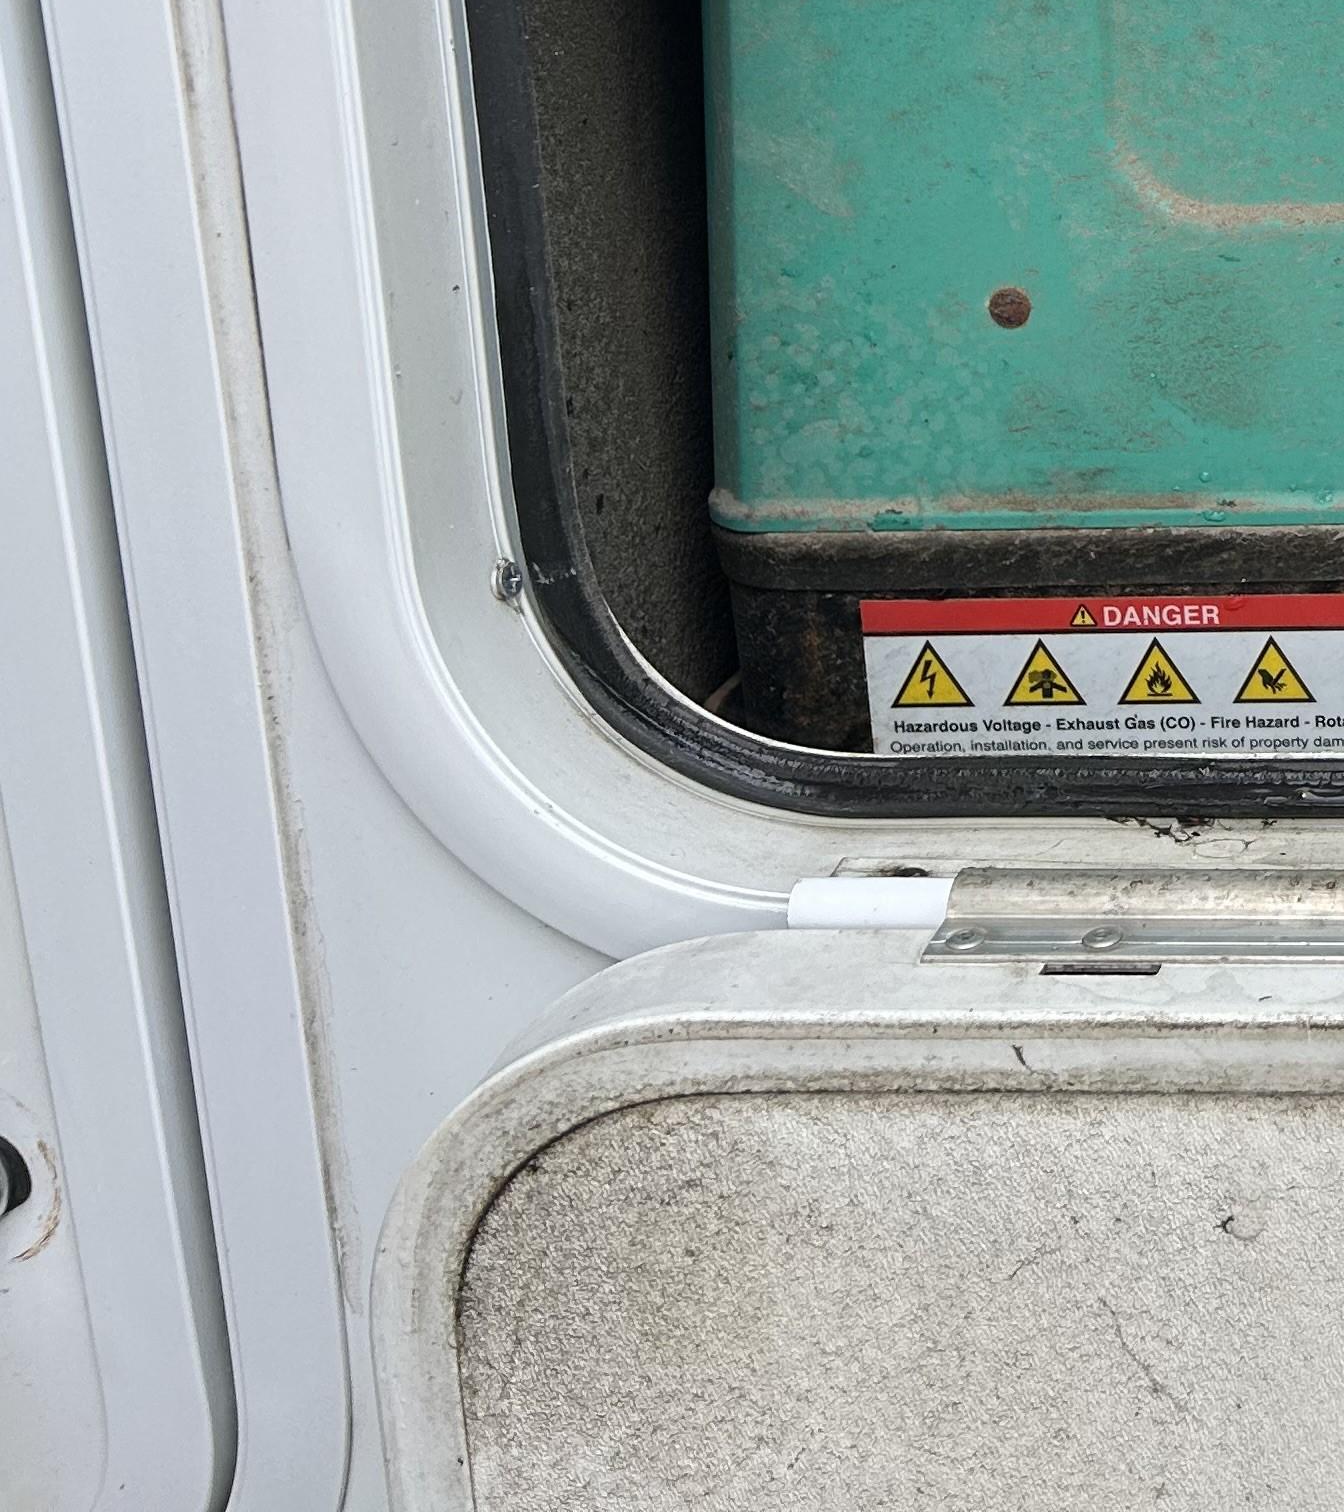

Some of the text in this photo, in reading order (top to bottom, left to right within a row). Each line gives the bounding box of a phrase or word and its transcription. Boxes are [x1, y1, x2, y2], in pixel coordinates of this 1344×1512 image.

[1103, 604, 1220, 626] DANGER
[893, 719, 978, 734] Hazardous
[982, 718, 1042, 734] Voltage
[1056, 717, 1121, 731] Exhaust
[1124, 717, 1156, 730] Gas
[1160, 715, 1196, 732] (CO)
[1211, 717, 1241, 729] Fire
[1245, 715, 1300, 729] Hazard
[889, 740, 966, 754] Operation,
[970, 738, 1050, 752] installation,
[1056, 738, 1084, 751] and
[1087, 737, 1140, 751] service
[1143, 737, 1199, 752] present
[1202, 736, 1227, 749] risk
[1231, 736, 1246, 749] of
[1250, 736, 1309, 752] property
